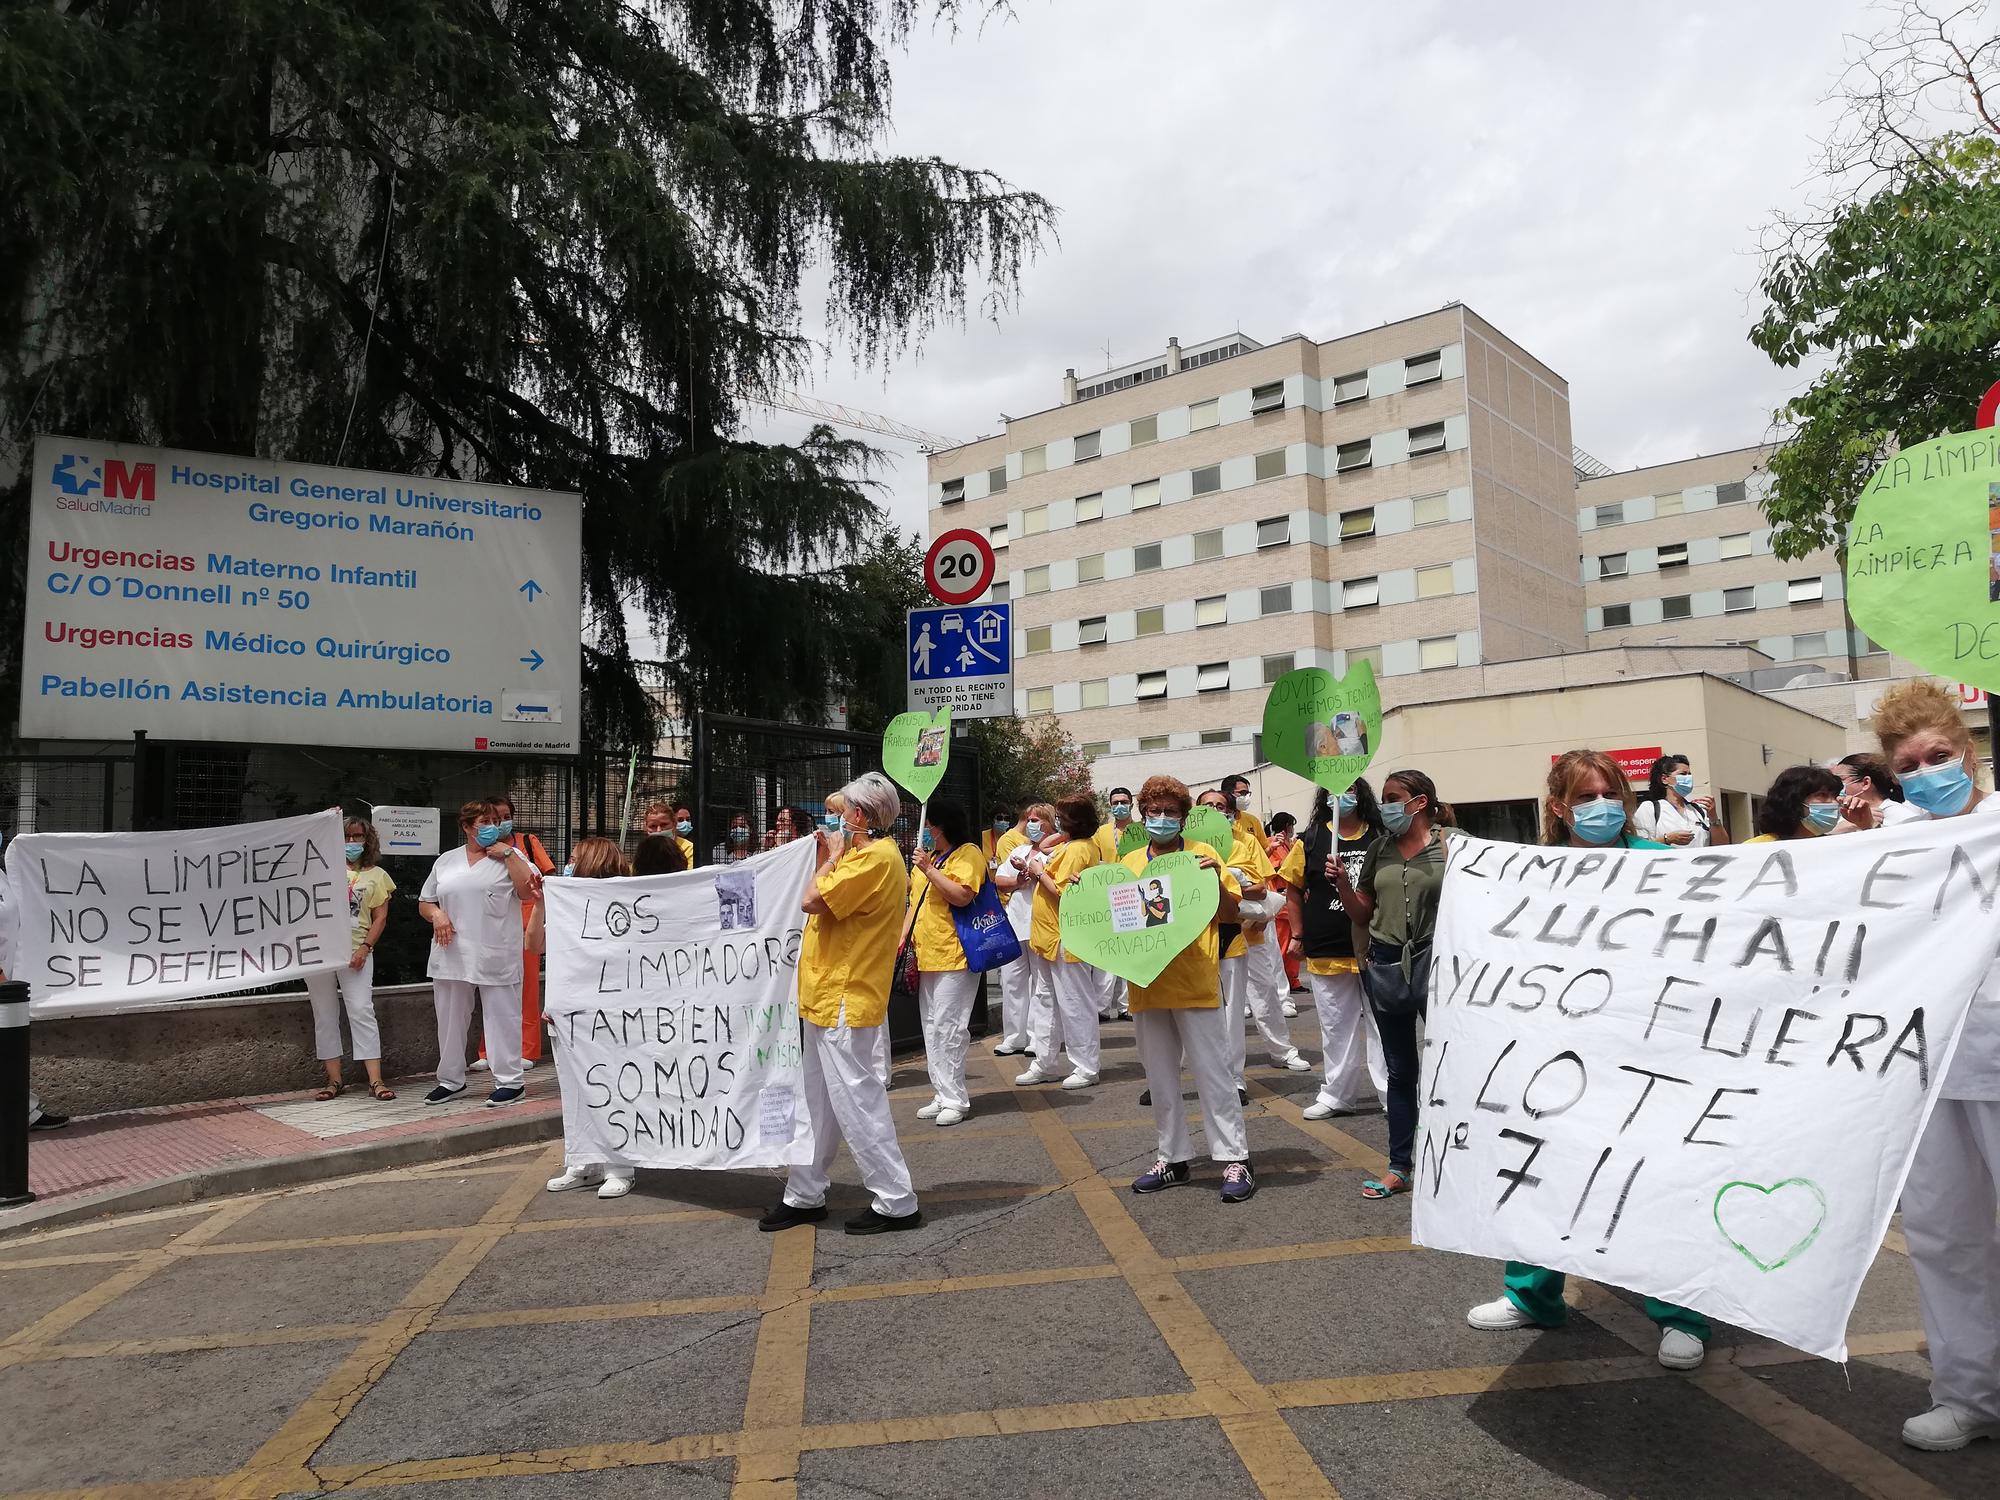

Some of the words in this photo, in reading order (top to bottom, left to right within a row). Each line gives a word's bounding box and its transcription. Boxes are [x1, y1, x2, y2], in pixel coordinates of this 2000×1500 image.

[171, 465, 280, 494] Hospital
[290, 478, 387, 505] General
[396, 488, 542, 521] Universitario
[1873, 457, 1911, 494] LA
[56, 497, 151, 517] SaludMadrid
[249, 502, 360, 531] Gregorio
[369, 514, 474, 541] Marañón
[1853, 523, 1884, 546] LA
[49, 541, 196, 571] Urgencias
[207, 553, 321, 581] Materno
[330, 563, 417, 589] Infantil
[940, 553, 977, 579] 20
[277, 590, 310, 610] 50
[45, 621, 193, 649] Urgencias
[205, 630, 306, 656] Médico
[316, 637, 450, 665] Quirúrgico
[41, 675, 170, 700] Pabellón
[180, 680, 327, 707] Asistencia
[336, 688, 493, 714] Ambulatoria
[914, 687, 925, 696] EN
[928, 686, 952, 695] TODO
[955, 685, 965, 693] EL
[968, 682, 1006, 692] RECINTO
[924, 695, 952, 704] USTED
[955, 694, 968, 702] NO
[971, 692, 995, 701] TIENE
[937, 702, 982, 712] PORIDAD
[489, 740, 531, 749] Comunidad
[533, 741, 543, 749] de
[40, 858, 106, 896] LA
[144, 839, 330, 896] LIMPIEZA
[1092, 867, 1126, 889] NOS
[1861, 844, 2000, 921] EN
[50, 906, 109, 943] NO
[127, 906, 182, 944] SE
[199, 881, 333, 937] VENDE
[581, 895, 660, 940] L@S
[1178, 888, 1201, 909] LA
[45, 955, 103, 987] SE
[127, 933, 323, 986] DEFIENDE
[1094, 931, 1167, 957] PRIVADA
[564, 999, 735, 1049] TAMBIEN
[1428, 955, 1614, 1019] AYUSO
[1643, 975, 1929, 1090] FUERA
[585, 1051, 736, 1109] SOMOS
[1475, 1039, 1760, 1148] LOTE
[607, 1105, 745, 1151] SANIDAD
[1419, 1121, 1471, 1200] Nº
